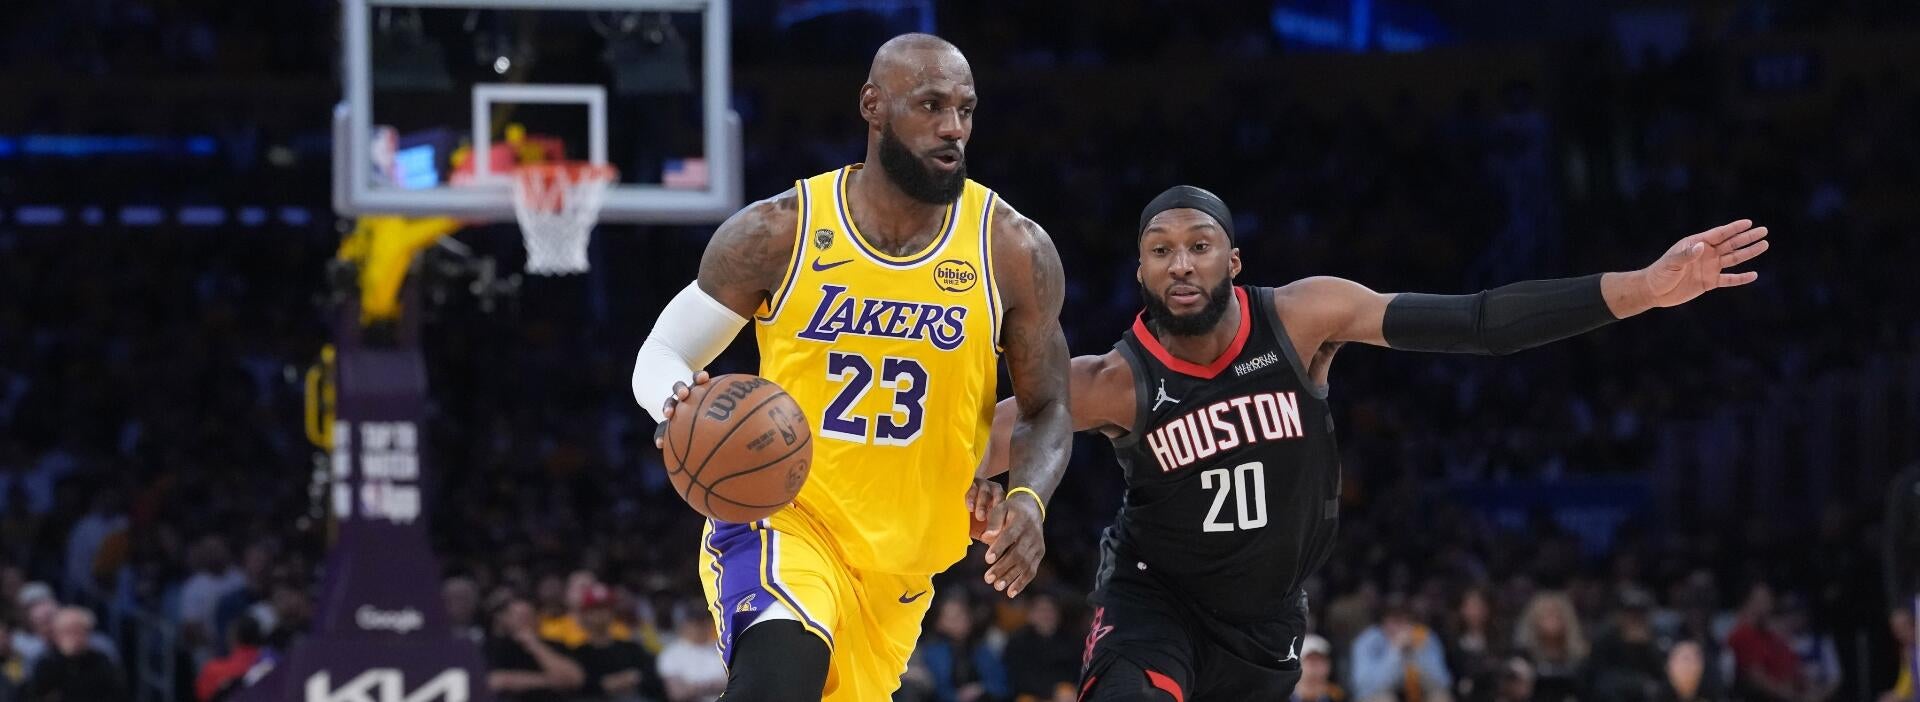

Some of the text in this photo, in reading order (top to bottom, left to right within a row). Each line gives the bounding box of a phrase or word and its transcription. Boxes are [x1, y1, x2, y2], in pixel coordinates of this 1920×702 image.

[937, 267, 975, 283] bibigo
[796, 284, 968, 351] LAKERS
[1234, 351, 1277, 371] MEMORIAL
[1236, 355, 1278, 376] HERMANN
[820, 350, 930, 447] 23
[1146, 391, 1304, 472] HOUSTON
[1200, 461, 1268, 533] 20
